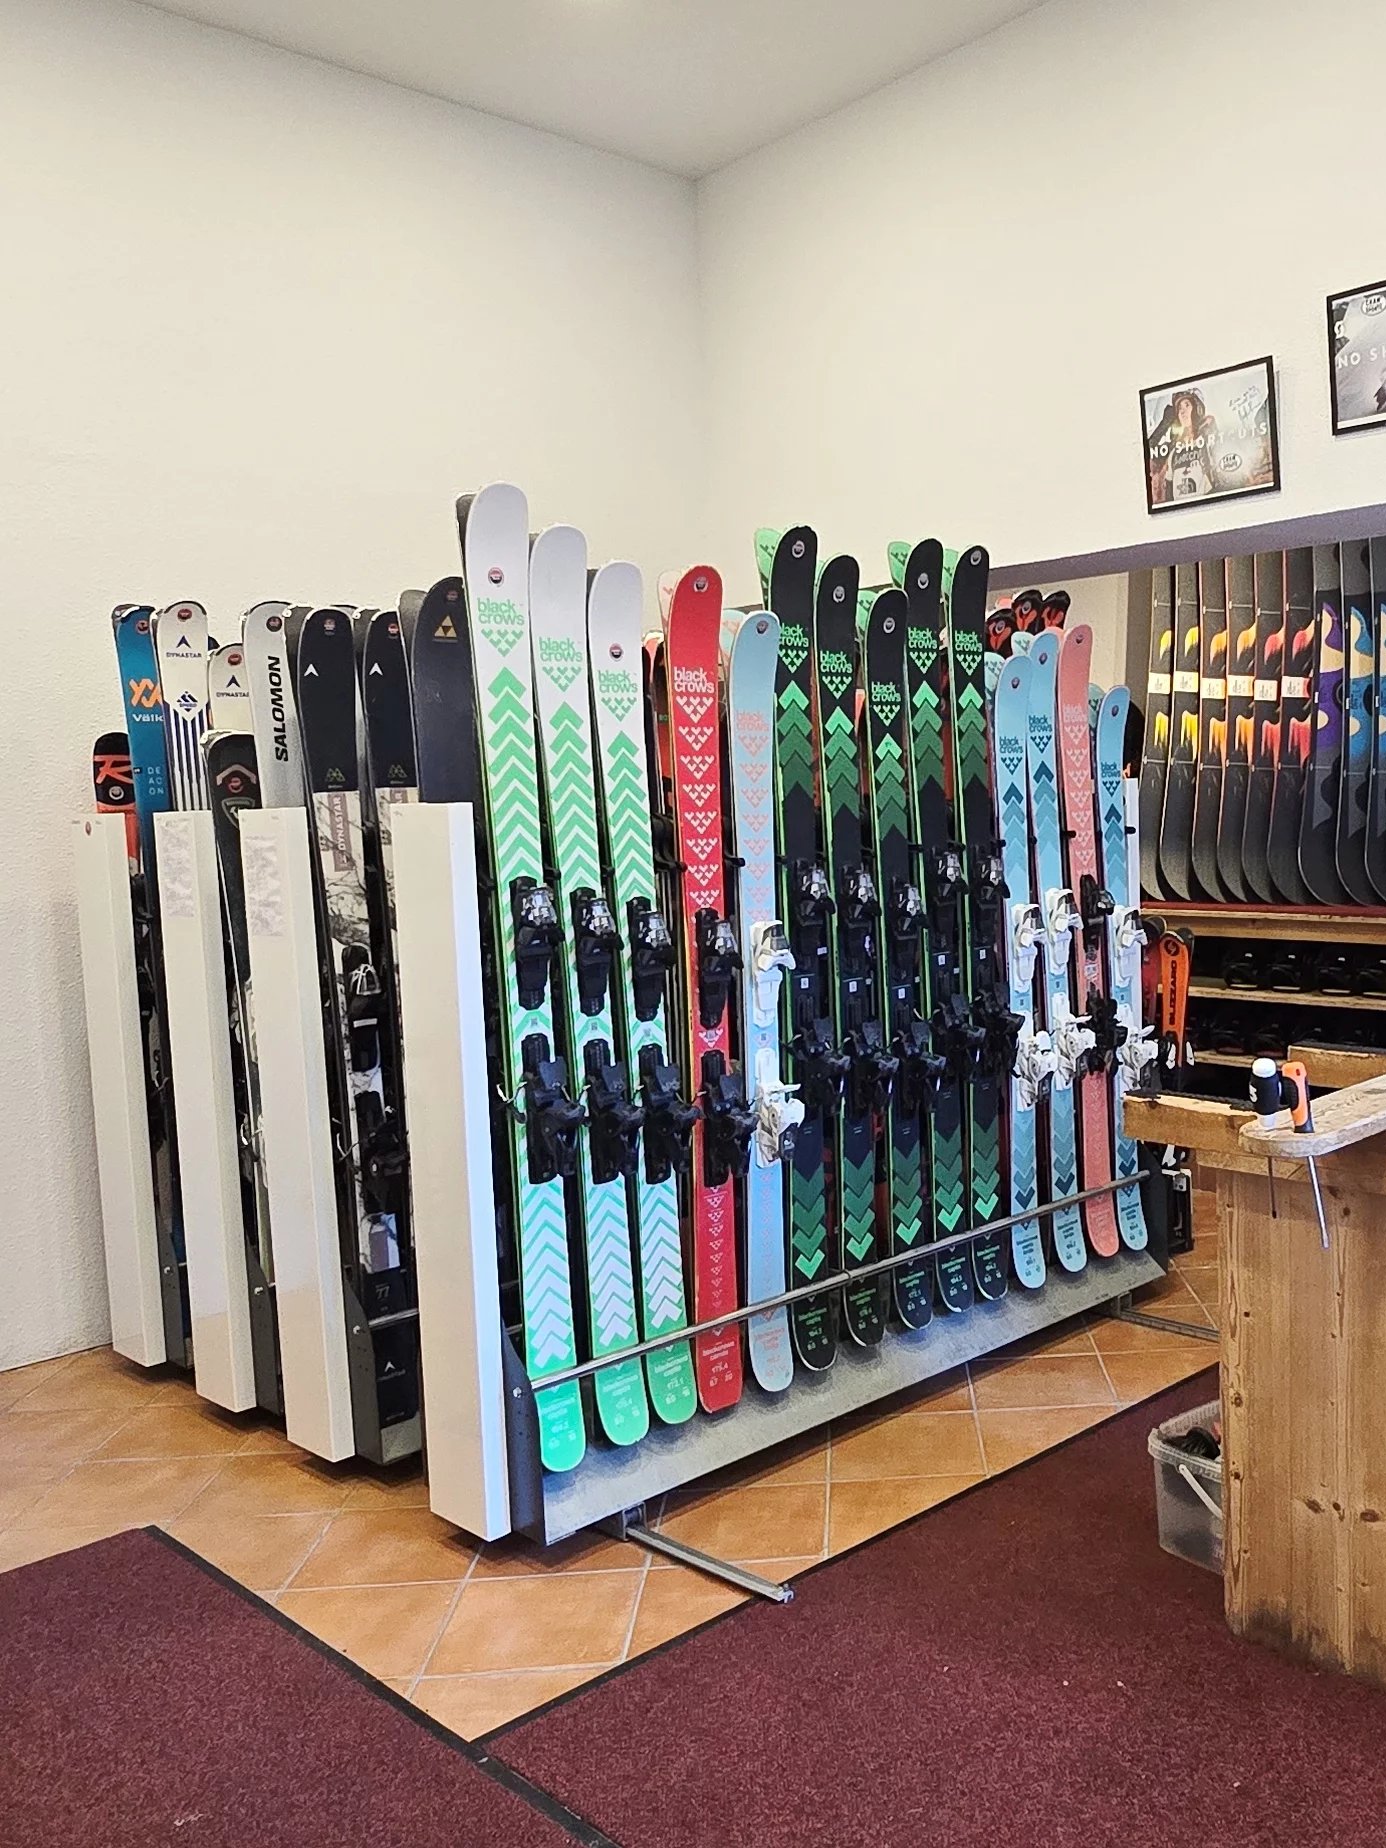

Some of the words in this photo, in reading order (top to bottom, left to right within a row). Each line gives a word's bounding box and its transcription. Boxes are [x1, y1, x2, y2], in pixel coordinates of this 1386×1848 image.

[1337, 352, 1361, 368] NO
[1150, 445, 1169, 459] NO
[477, 597, 516, 613] black
[478, 613, 525, 625] crows
[780, 622, 803, 637] lack
[908, 627, 932, 639] black
[955, 630, 978, 641] black
[539, 636, 576, 652] black
[908, 639, 938, 649] crows
[955, 641, 983, 652] crows
[540, 651, 583, 662] crows
[820, 650, 847, 663] black
[673, 666, 707, 682] black
[820, 662, 853, 674] crows
[598, 670, 631, 683] black
[599, 682, 638, 693] crows
[674, 681, 715, 694] crows
[872, 681, 896, 693] black
[871, 692, 901, 702] crows
[268, 655, 289, 762] SALOMON
[132, 713, 165, 722] Völk
[1028, 715, 1049, 725] black
[1029, 724, 1053, 733] crows
[1000, 736, 1019, 746] black
[1000, 745, 1023, 754] crows
